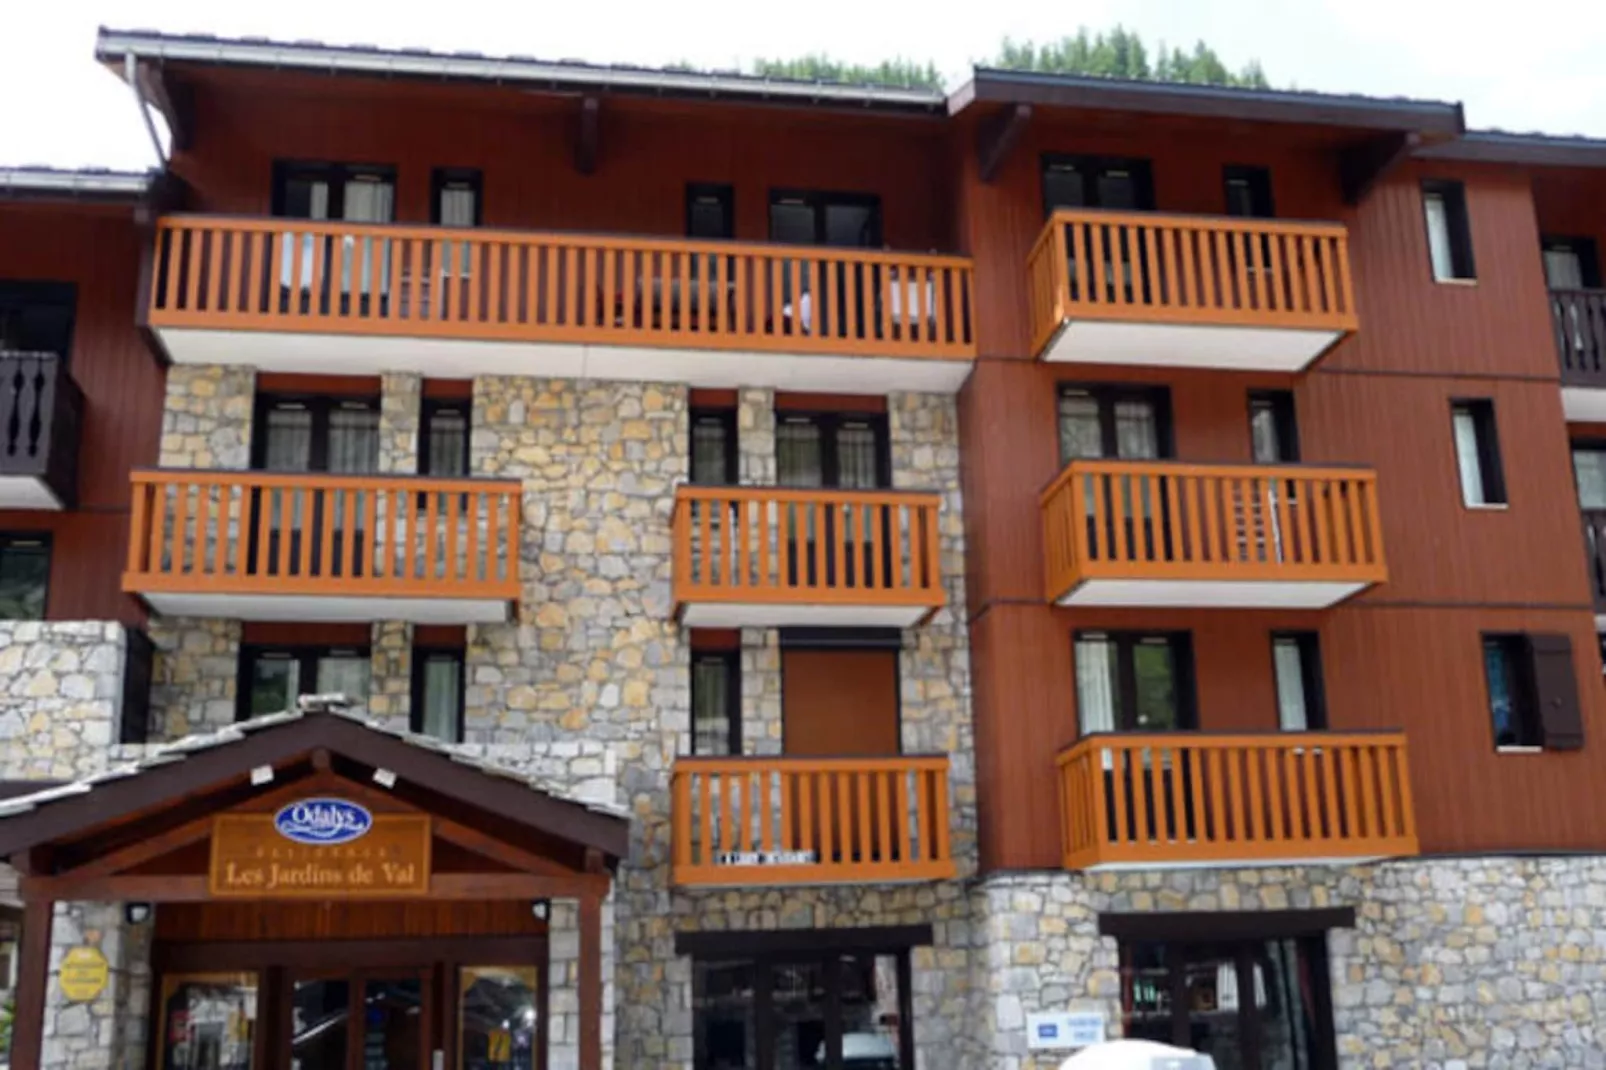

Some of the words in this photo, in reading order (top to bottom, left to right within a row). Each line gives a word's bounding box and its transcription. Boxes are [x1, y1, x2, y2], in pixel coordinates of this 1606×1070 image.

[292, 803, 356, 834] Odalys
[226, 862, 263, 885] Les
[266, 862, 341, 889] Jardins
[349, 862, 373, 884] de
[382, 862, 415, 884] Val
